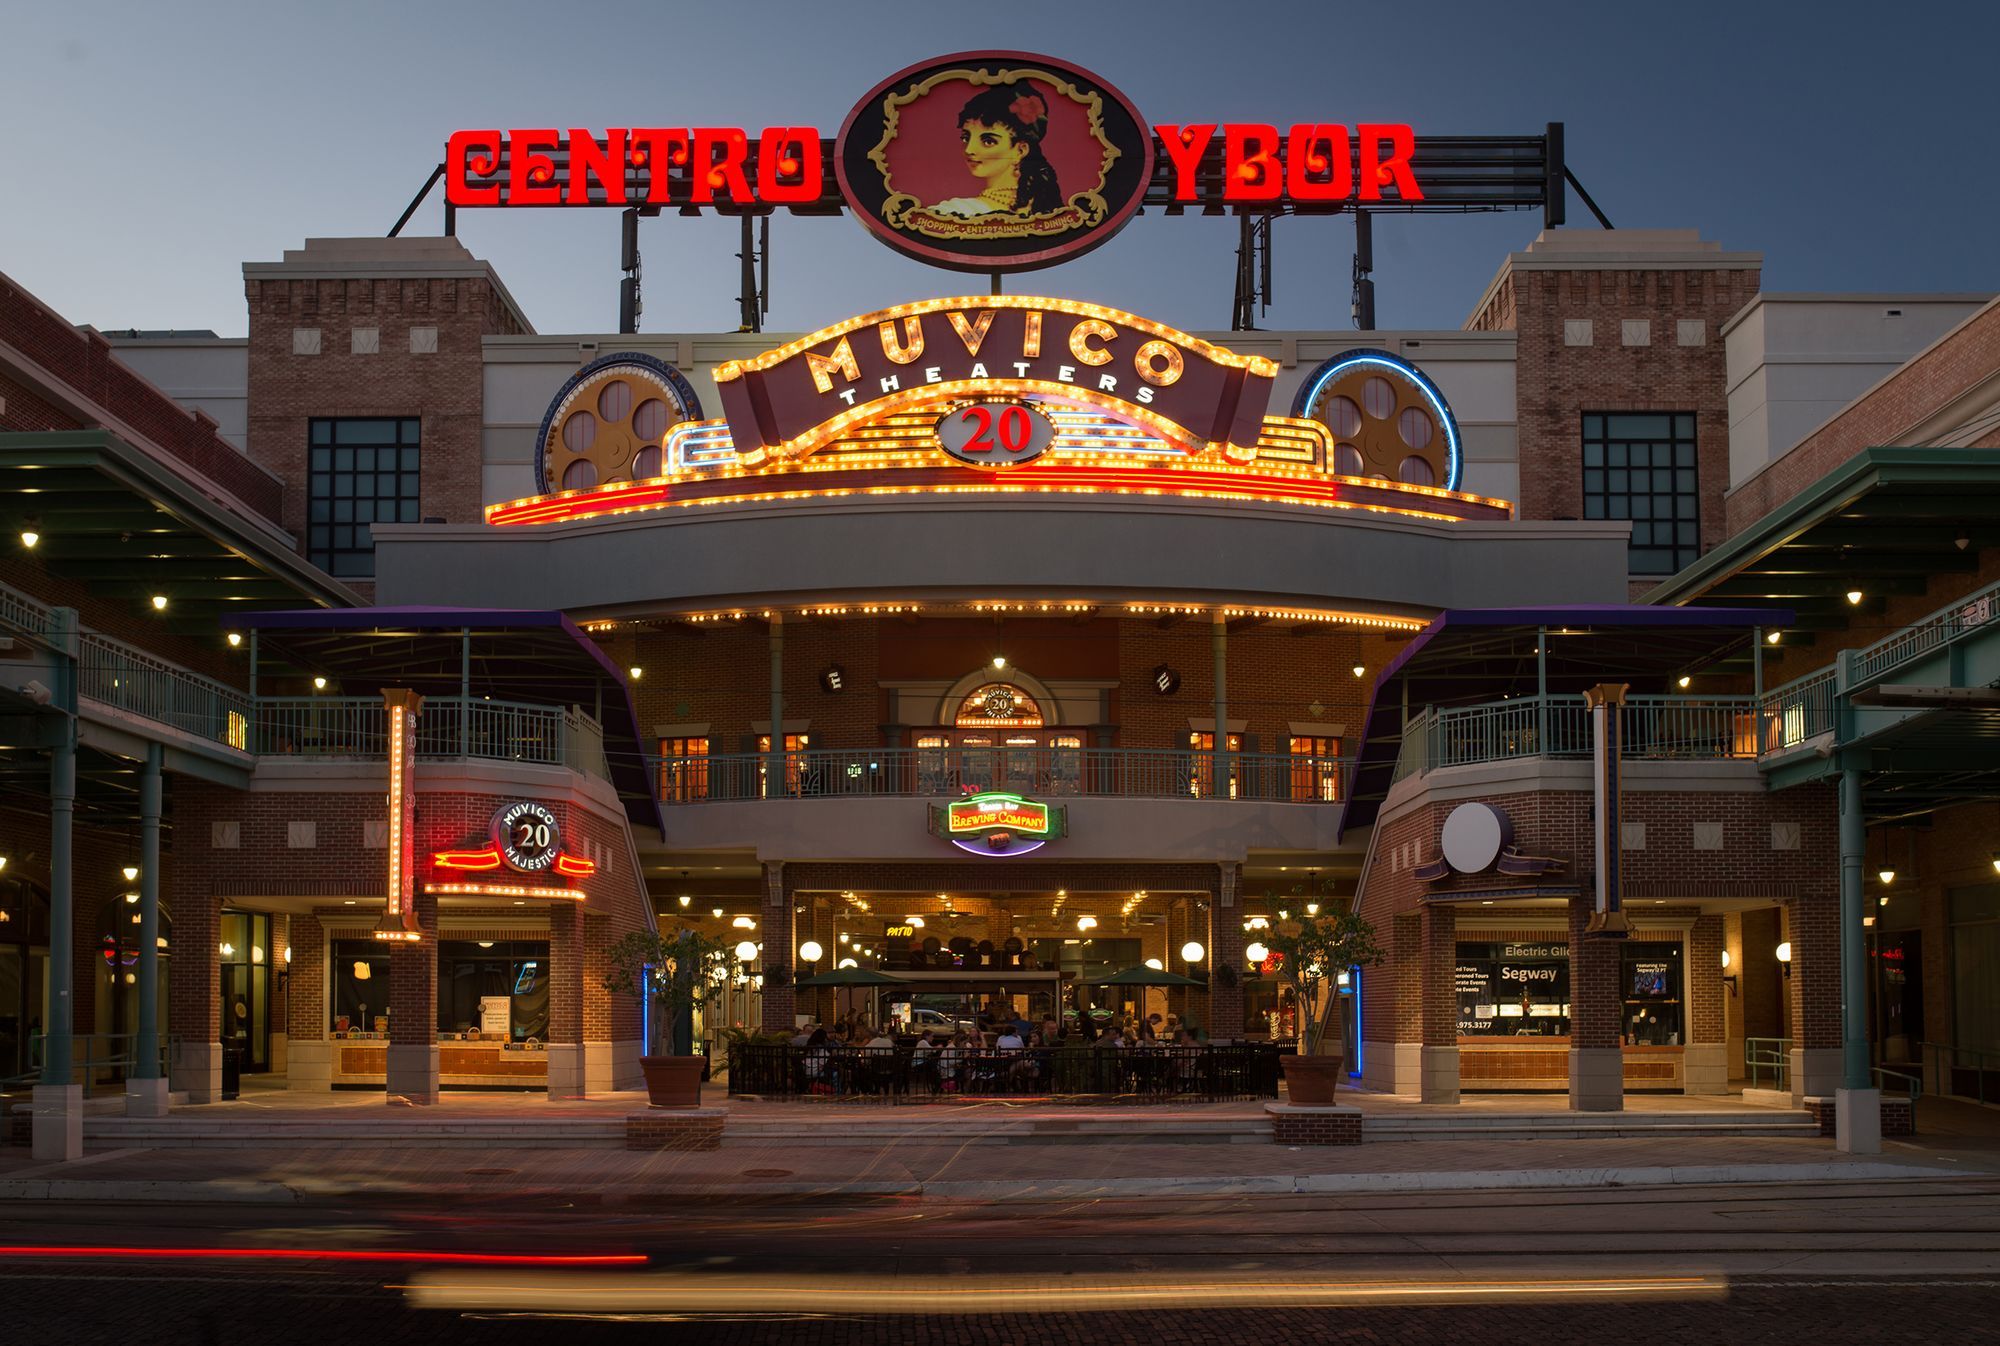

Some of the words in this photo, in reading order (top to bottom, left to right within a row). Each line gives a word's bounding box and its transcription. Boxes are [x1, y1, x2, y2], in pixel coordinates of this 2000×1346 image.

[447, 127, 822, 205] CENTRO
[1153, 124, 1425, 200] YBOR
[916, 216, 960, 233] SHOPPING
[966, 222, 1036, 234] ENTERTAINMENT
[1043, 214, 1075, 230] DINING
[805, 311, 1184, 394] MUVICO
[839, 362, 1154, 406] THEATERS
[961, 406, 1033, 452] 20
[992, 699, 1007, 710] 20
[503, 803, 553, 826] MUVICO
[952, 813, 997, 827] BREWING
[998, 811, 1044, 827] COMPANY
[517, 824, 550, 848] 20
[505, 846, 556, 869] MAJESTIC
[887, 926, 913, 937] PATIO
[1505, 946, 1548, 957] Electric
[1501, 966, 1557, 982] Segway
